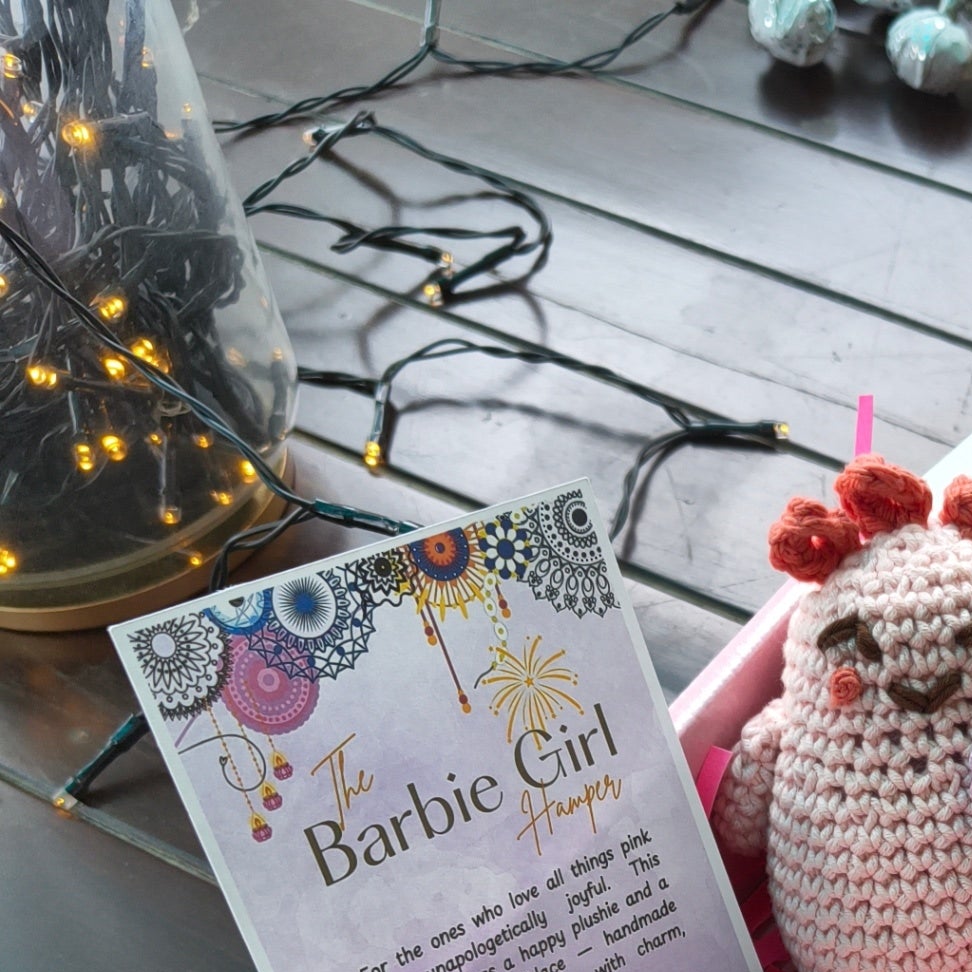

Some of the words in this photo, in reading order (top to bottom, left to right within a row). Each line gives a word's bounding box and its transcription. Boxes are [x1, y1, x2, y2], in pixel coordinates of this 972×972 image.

[303, 772, 503, 887] Barbie
[514, 703, 618, 789] Girl
[311, 733, 374, 831] The
[516, 774, 622, 856] Hamper
[396, 944, 423, 967] the
[430, 924, 466, 949] ones
[471, 904, 503, 928] who
[508, 885, 540, 909] love
[546, 869, 565, 891] all
[570, 850, 615, 879] things
[621, 828, 652, 858] pink
[503, 958, 515, 971] a
[519, 929, 566, 962] happy
[571, 901, 620, 939] plushie
[625, 882, 652, 906] and
[658, 878, 669, 890] a
[566, 878, 611, 914] joyful.
[629, 852, 661, 877] This
[603, 899, 678, 944] handmade
[636, 926, 687, 957] charm,
